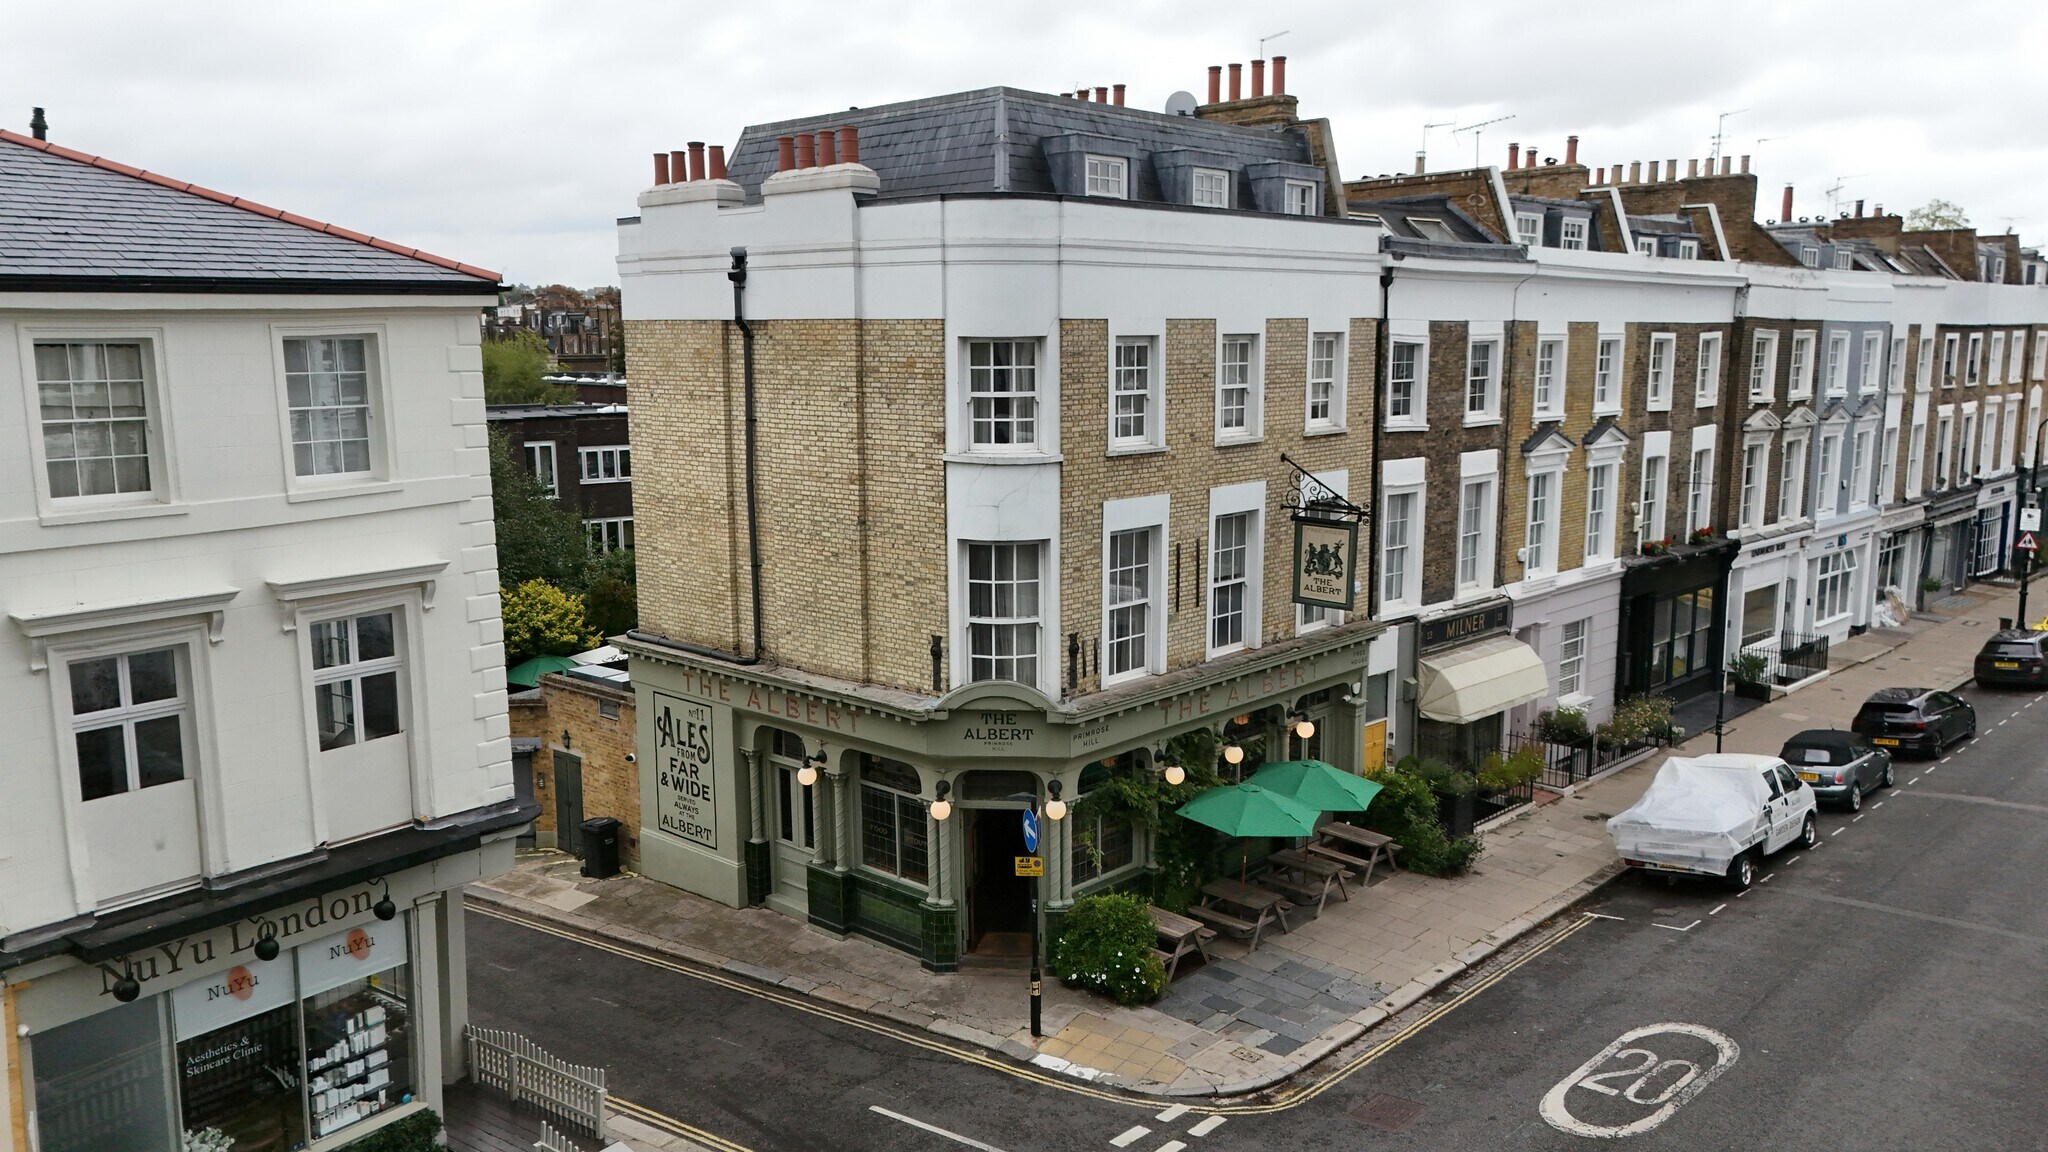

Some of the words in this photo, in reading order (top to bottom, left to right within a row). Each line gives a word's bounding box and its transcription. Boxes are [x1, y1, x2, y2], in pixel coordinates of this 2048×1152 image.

[1303, 584, 1342, 596] ALBERT
[1313, 577, 1333, 587] THE
[1446, 613, 1485, 639] MILNER
[682, 669, 731, 702] THE
[747, 688, 861, 733] ALBERT
[1160, 690, 1210, 725] THE
[1226, 659, 1321, 707] ALBERT
[980, 712, 1017, 725] THE
[657, 706, 711, 764] ALES
[963, 728, 1034, 741] ALBERT
[1072, 725, 1110, 742] PRIMROSE
[1082, 738, 1100, 747] HILL
[676, 747, 696, 761] FROM
[670, 757, 699, 780] FAR
[661, 771, 669, 787] &
[670, 774, 711, 802] WIDE
[674, 801, 699, 815] ALWAYS
[662, 814, 712, 841] ALBERT
[95, 938, 216, 997] NuYu
[227, 890, 374, 955] London
[329, 937, 376, 960] NuYu
[207, 975, 259, 1001] NuYu
[186, 1041, 238, 1067] Aesthetics
[240, 1036, 250, 1046] &
[186, 1055, 231, 1078] Skincare
[233, 1043, 263, 1060] Clinic
[1577, 1048, 1701, 1105] 20
